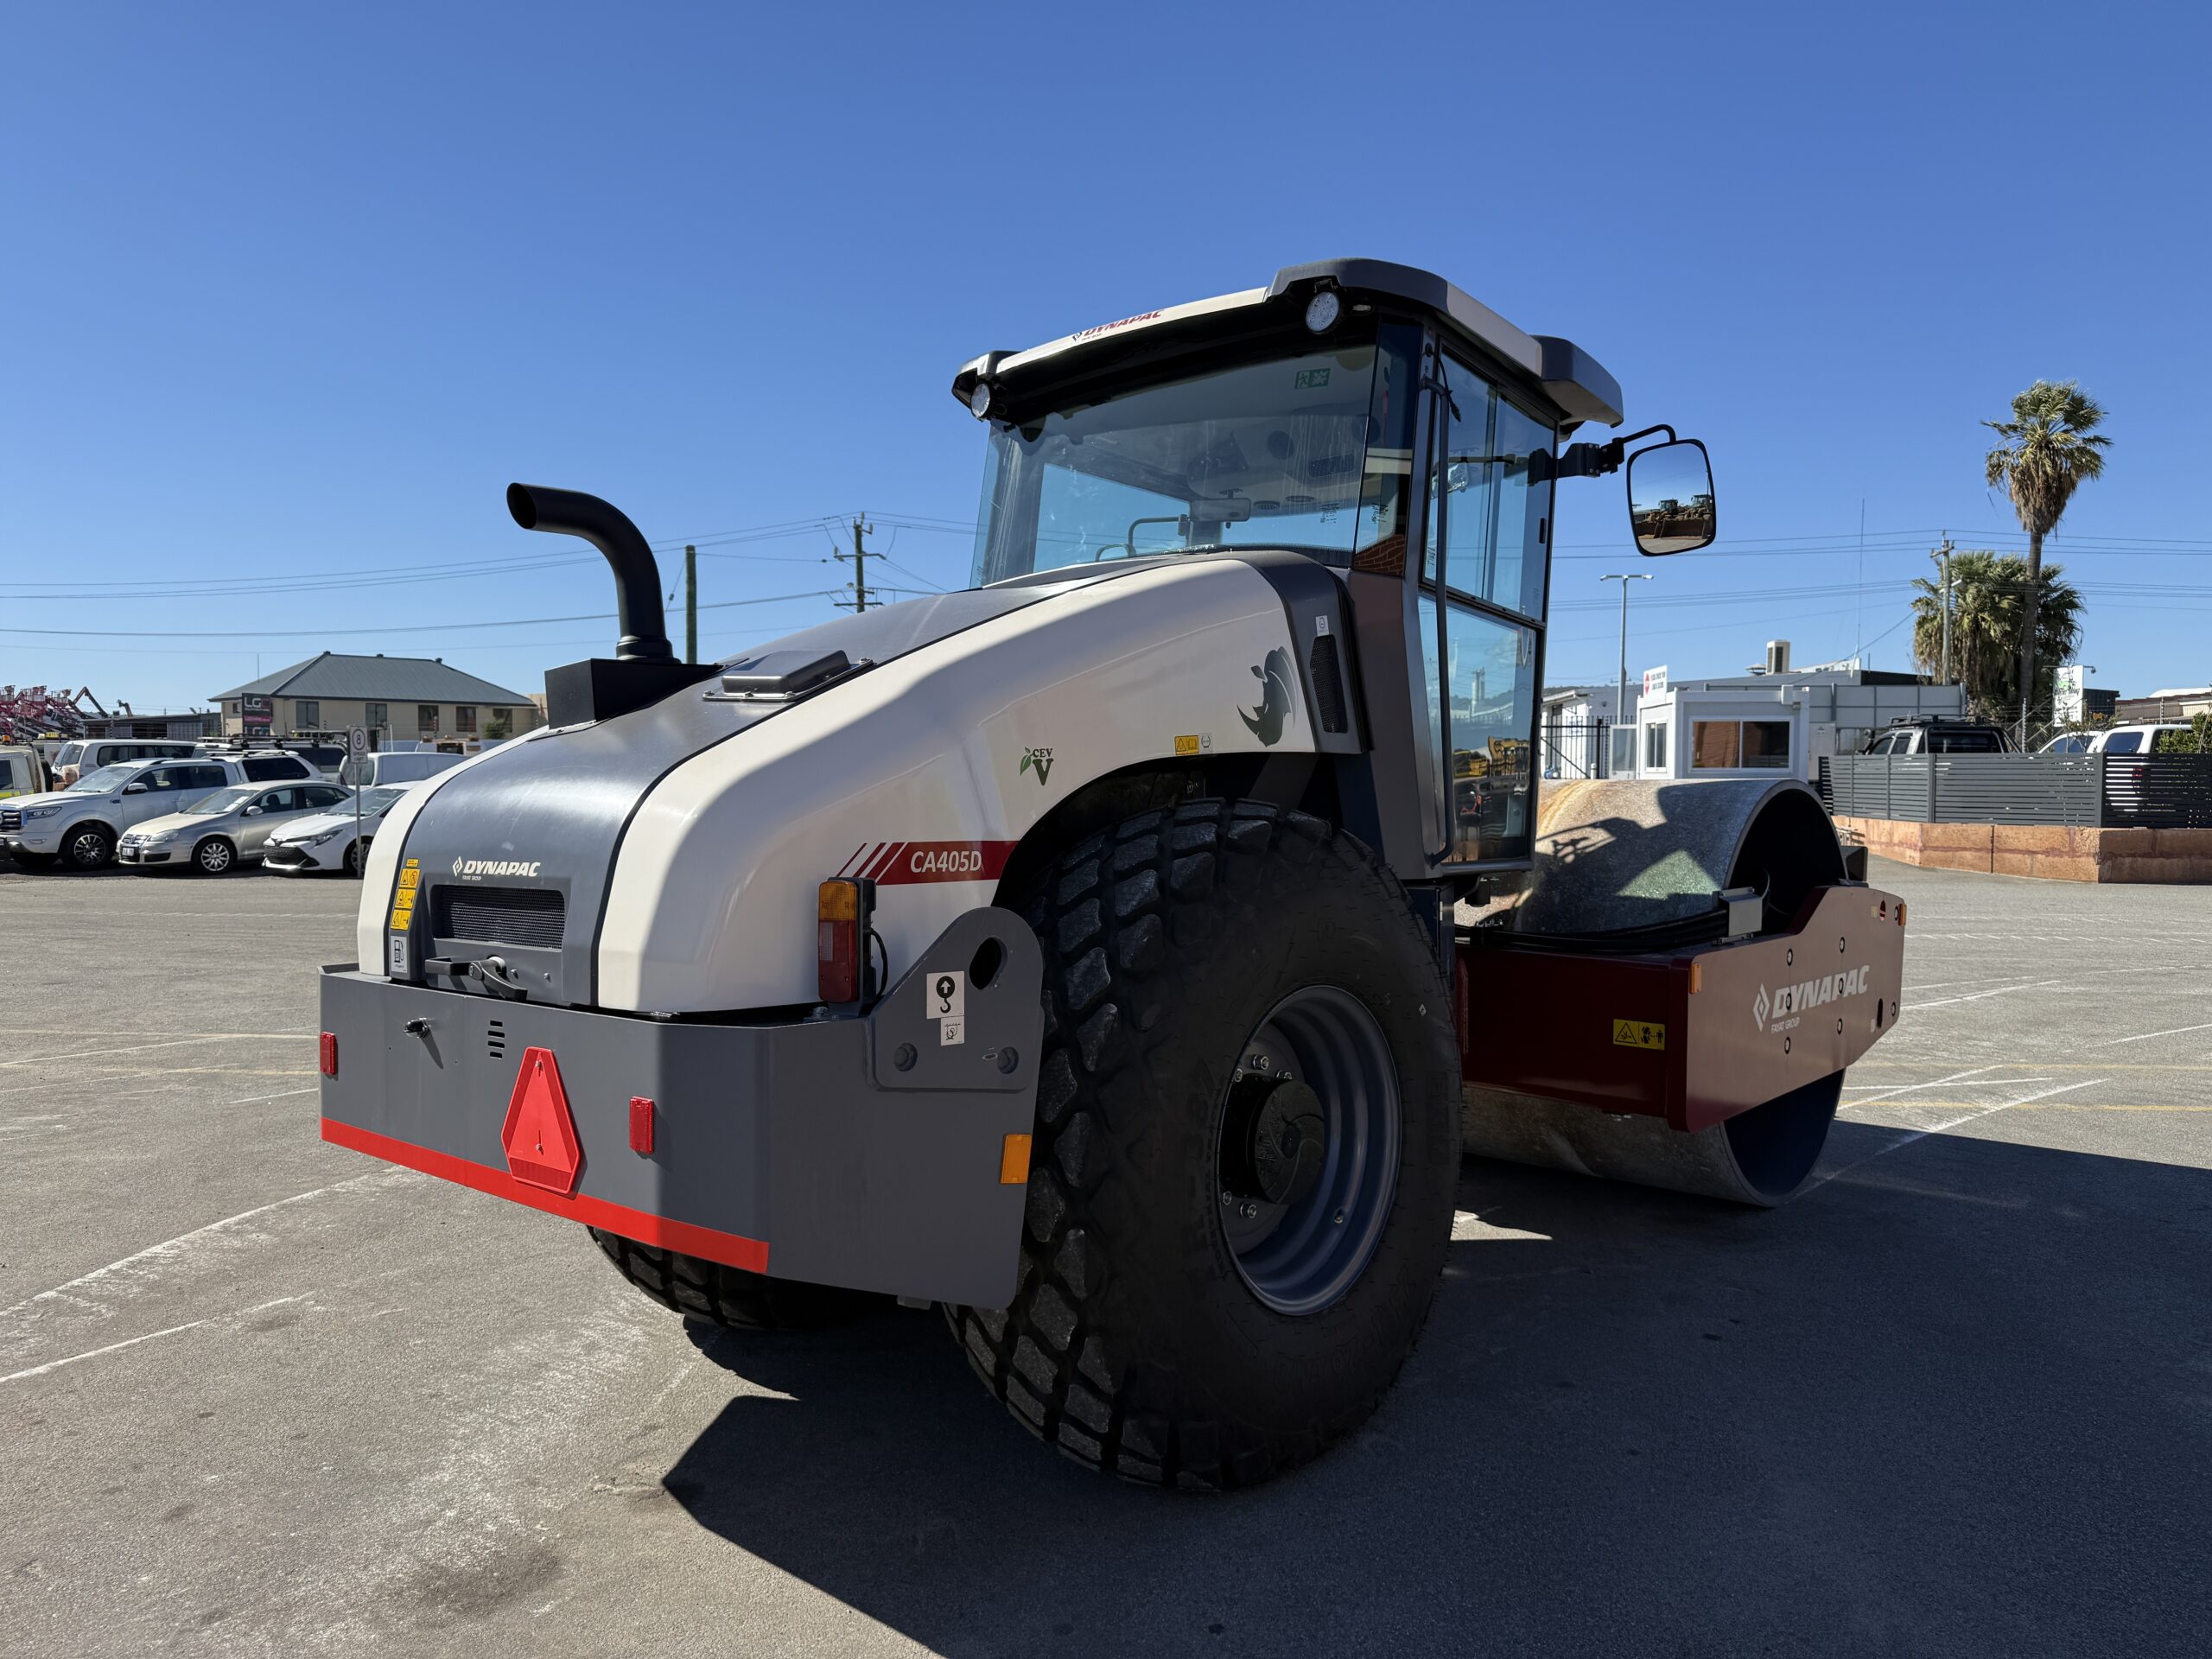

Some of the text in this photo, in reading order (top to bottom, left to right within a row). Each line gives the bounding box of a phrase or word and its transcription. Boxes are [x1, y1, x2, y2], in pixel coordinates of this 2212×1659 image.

[1084, 309, 1164, 336] DYNAPAC
[1033, 747, 1053, 758] CEV
[1033, 758, 1054, 786] V
[463, 860, 541, 877] DYNAPAC
[910, 850, 982, 873] CA405D
[1771, 964, 1870, 1020] DYNAPAC
[1784, 1016, 1800, 1030] GROUP
